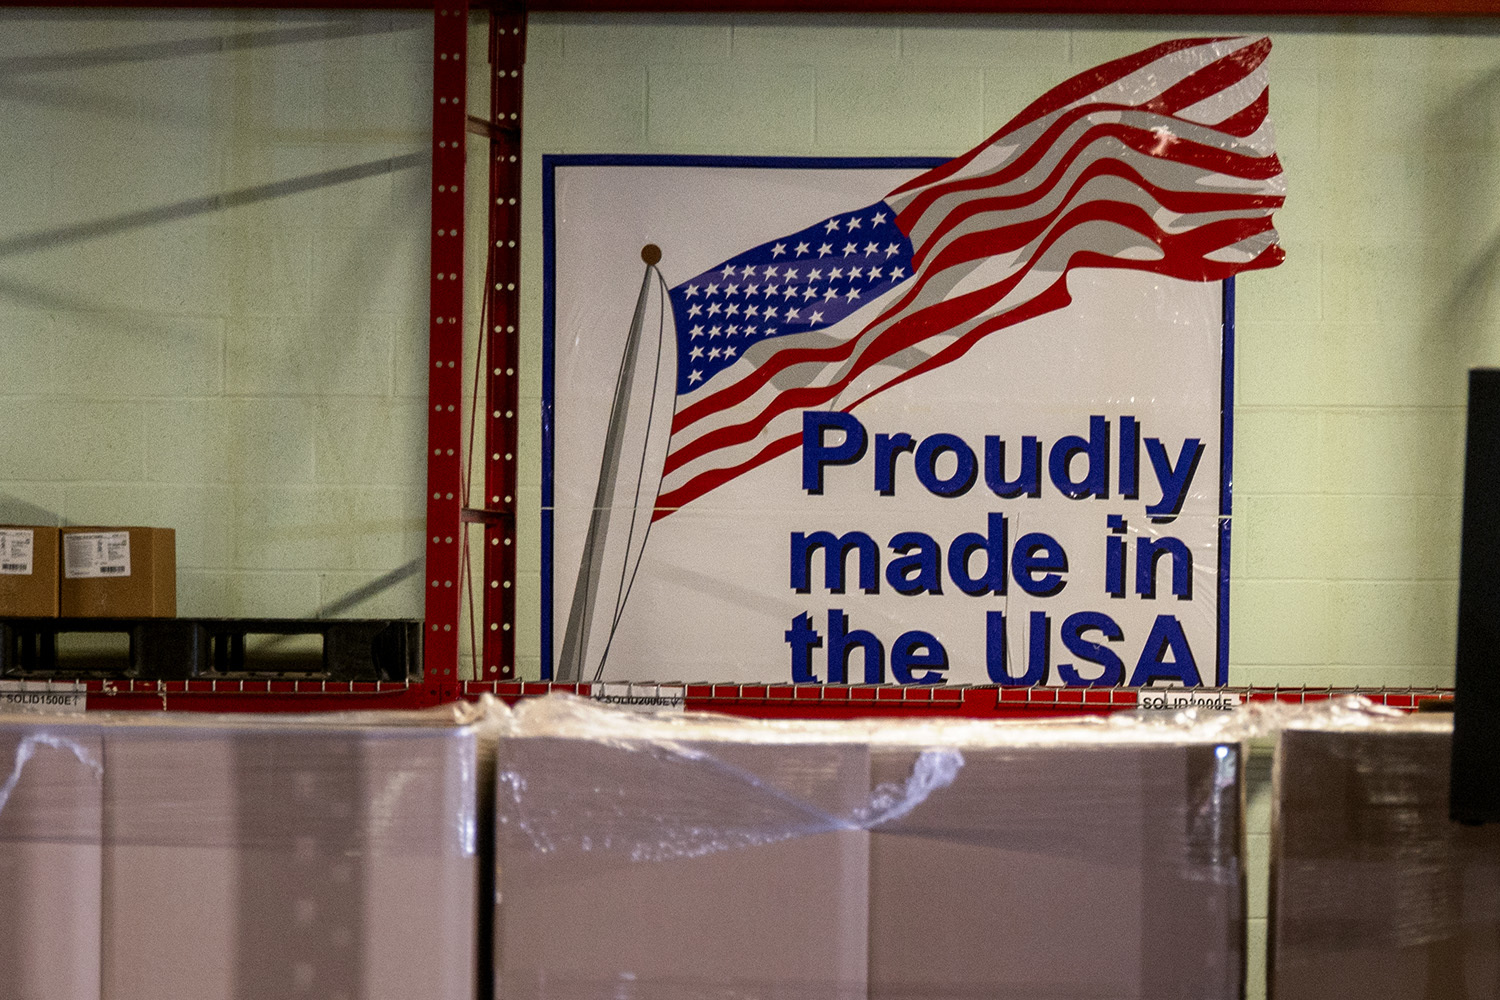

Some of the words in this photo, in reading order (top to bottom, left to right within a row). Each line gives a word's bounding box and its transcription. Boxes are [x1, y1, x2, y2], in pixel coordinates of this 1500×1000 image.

[802, 410, 1206, 524] Proudly
[790, 512, 1069, 596] made
[1105, 514, 1193, 600] in
[785, 608, 949, 685] the
[985, 610, 1204, 688] USA
[6, 693, 72, 706] SOLID1500E
